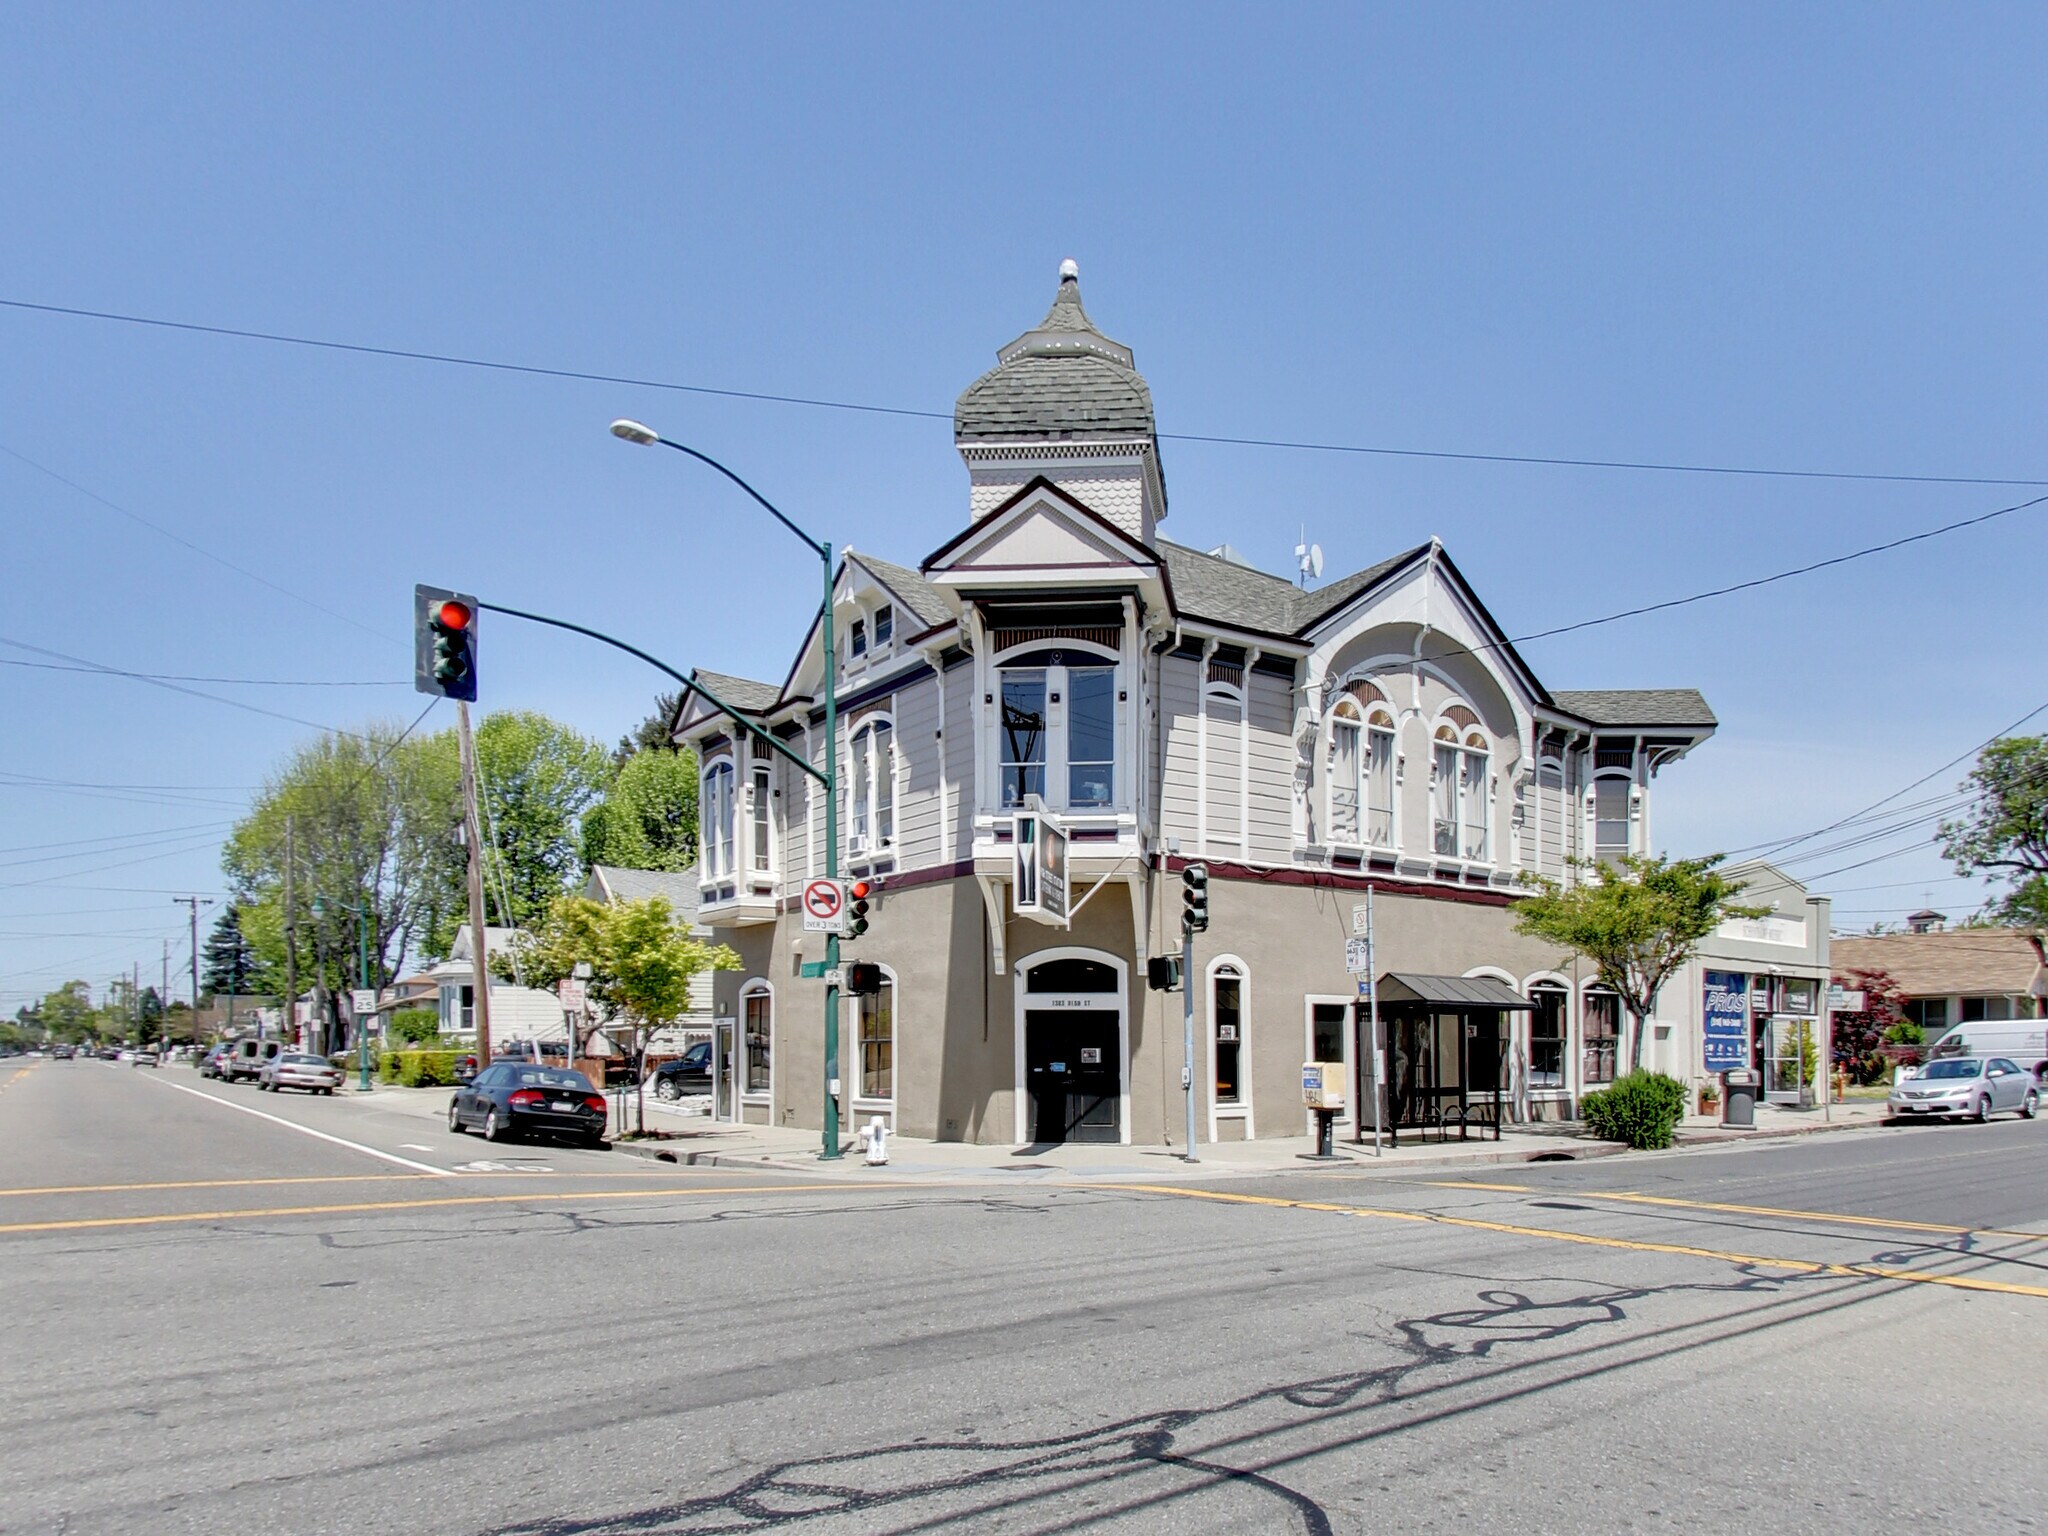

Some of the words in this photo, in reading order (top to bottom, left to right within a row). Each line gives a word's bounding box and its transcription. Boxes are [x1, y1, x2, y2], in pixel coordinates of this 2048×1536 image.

[821, 921, 827, 929] 3
[1705, 991, 1746, 1012] PROS
[356, 1002, 373, 1010] 25
